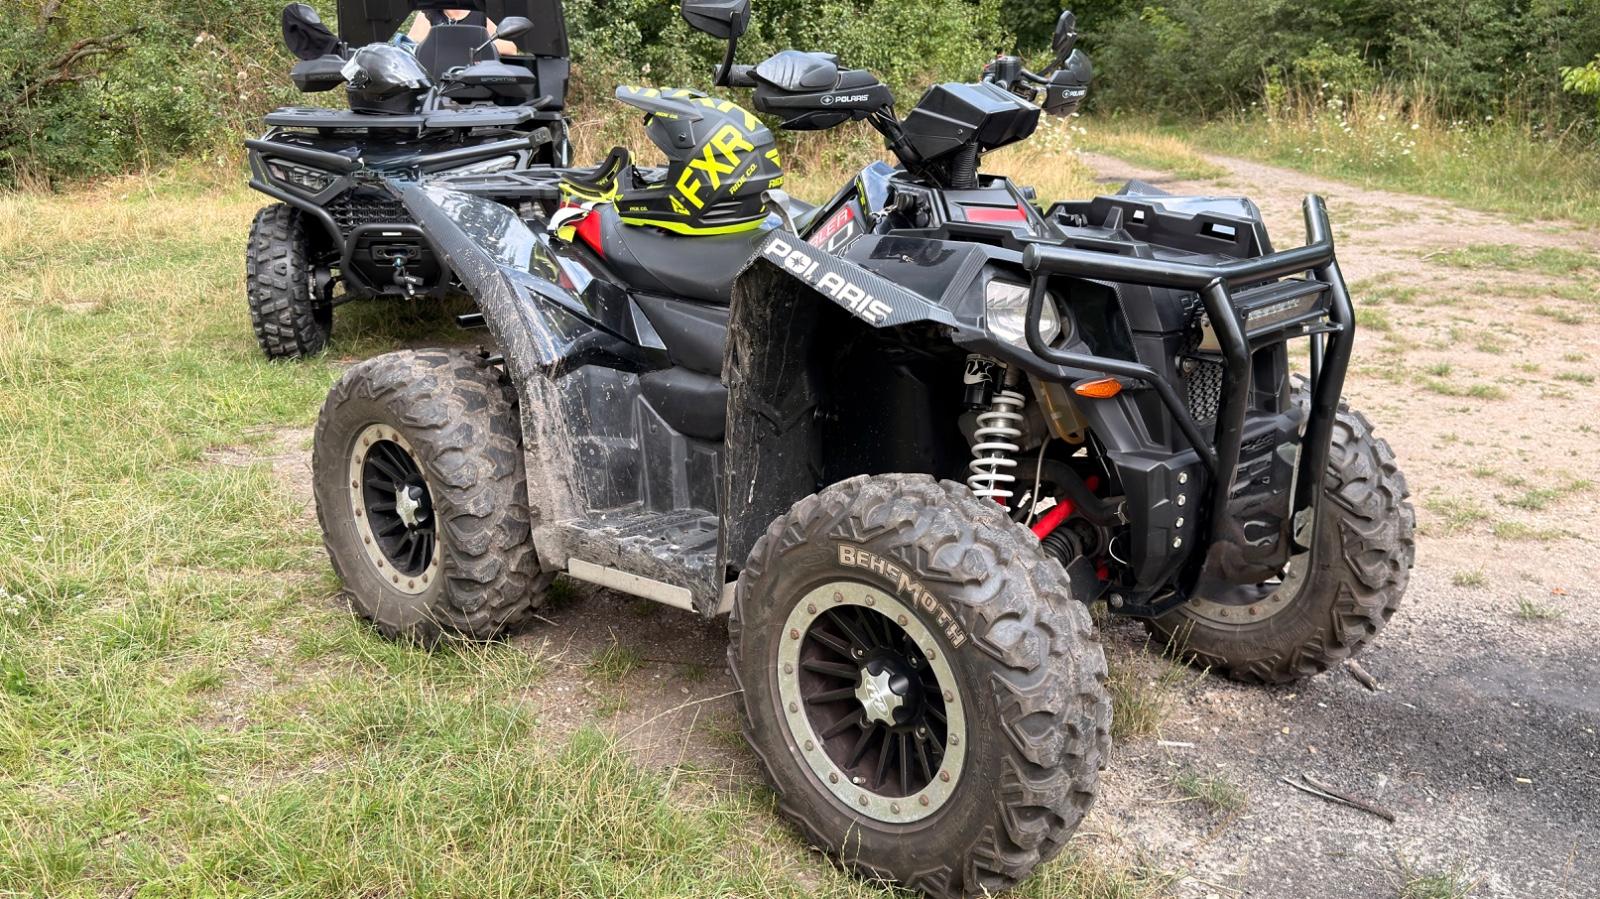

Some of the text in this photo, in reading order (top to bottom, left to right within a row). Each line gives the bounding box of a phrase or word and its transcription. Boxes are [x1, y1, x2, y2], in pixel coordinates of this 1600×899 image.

[835, 94, 869, 103] POLARIS
[675, 124, 755, 209] FXR
[729, 174, 747, 195] RIDE
[763, 238, 893, 323] POLARIS
[838, 543, 968, 649] BEHEMOTH
